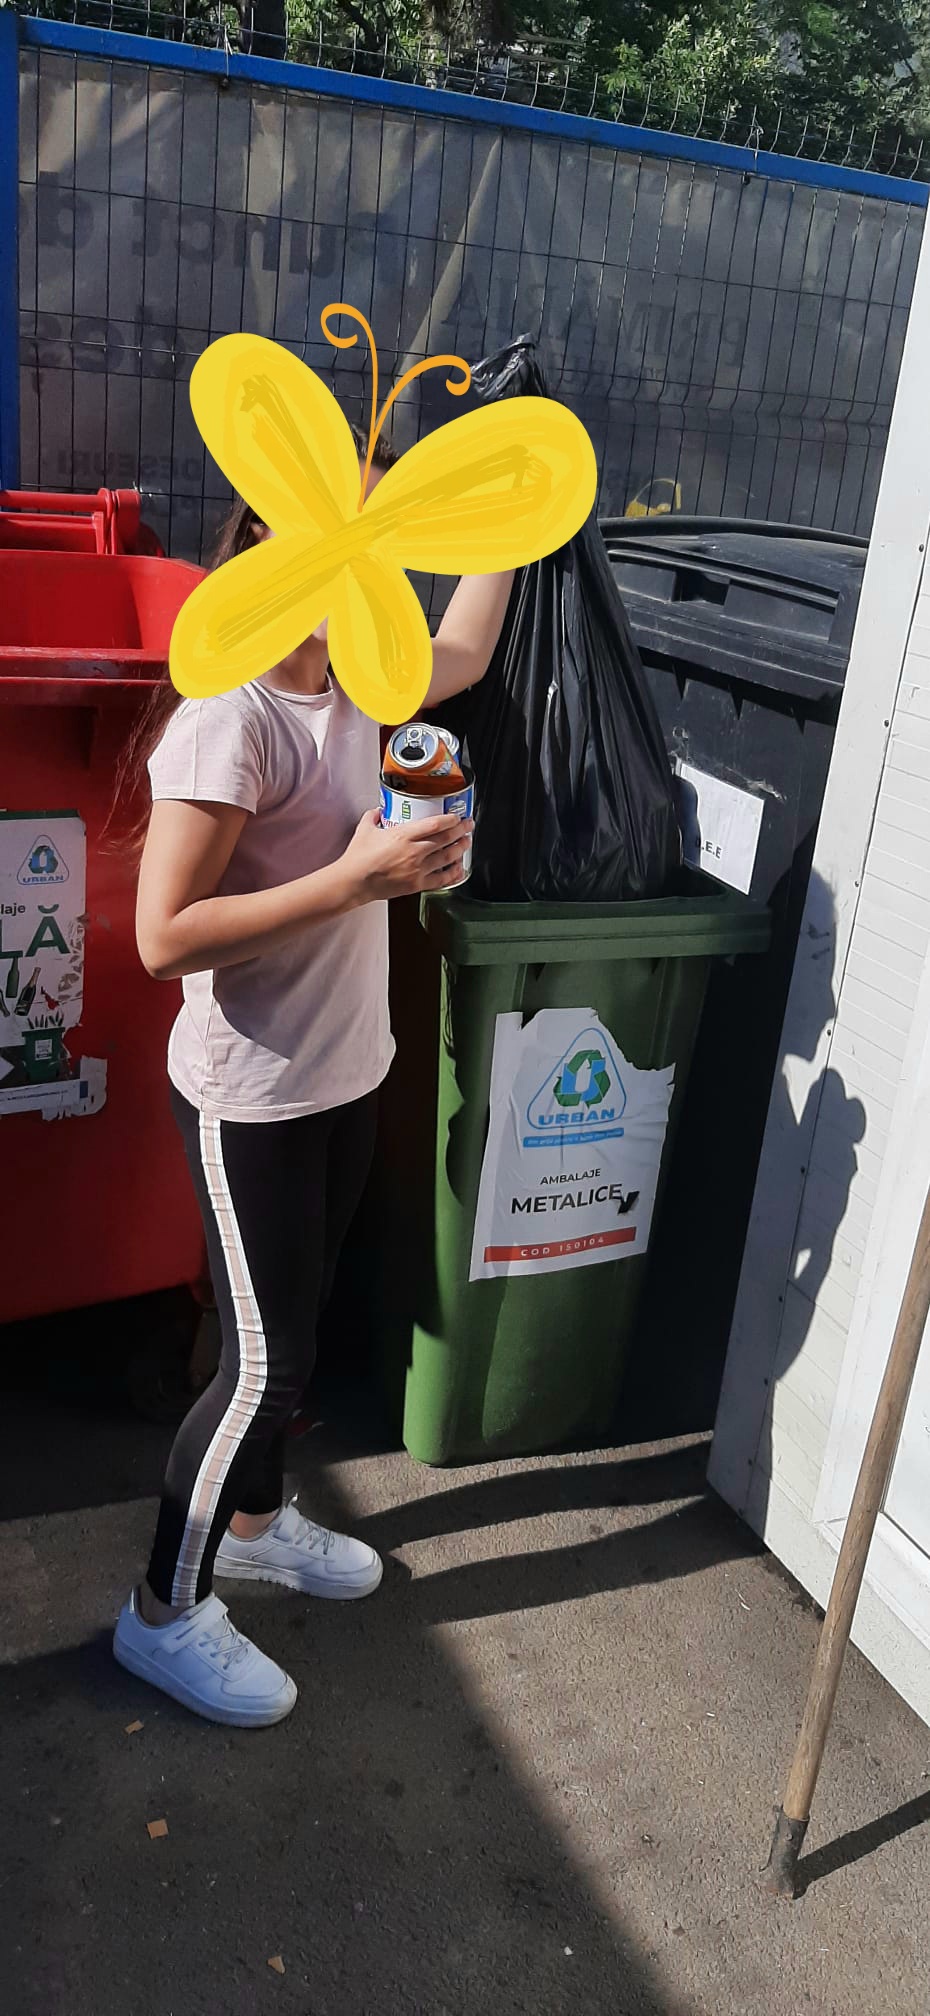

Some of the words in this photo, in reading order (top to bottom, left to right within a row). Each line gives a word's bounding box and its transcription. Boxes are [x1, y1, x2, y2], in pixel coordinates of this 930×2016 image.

[22, 875, 64, 883] URBAN
[538, 1108, 615, 1126] URBAN
[540, 1168, 602, 1185] AMBALAJE
[511, 1183, 624, 1214] METALICE
[520, 1247, 550, 1258] COD
[559, 1236, 605, 1253] 150104
